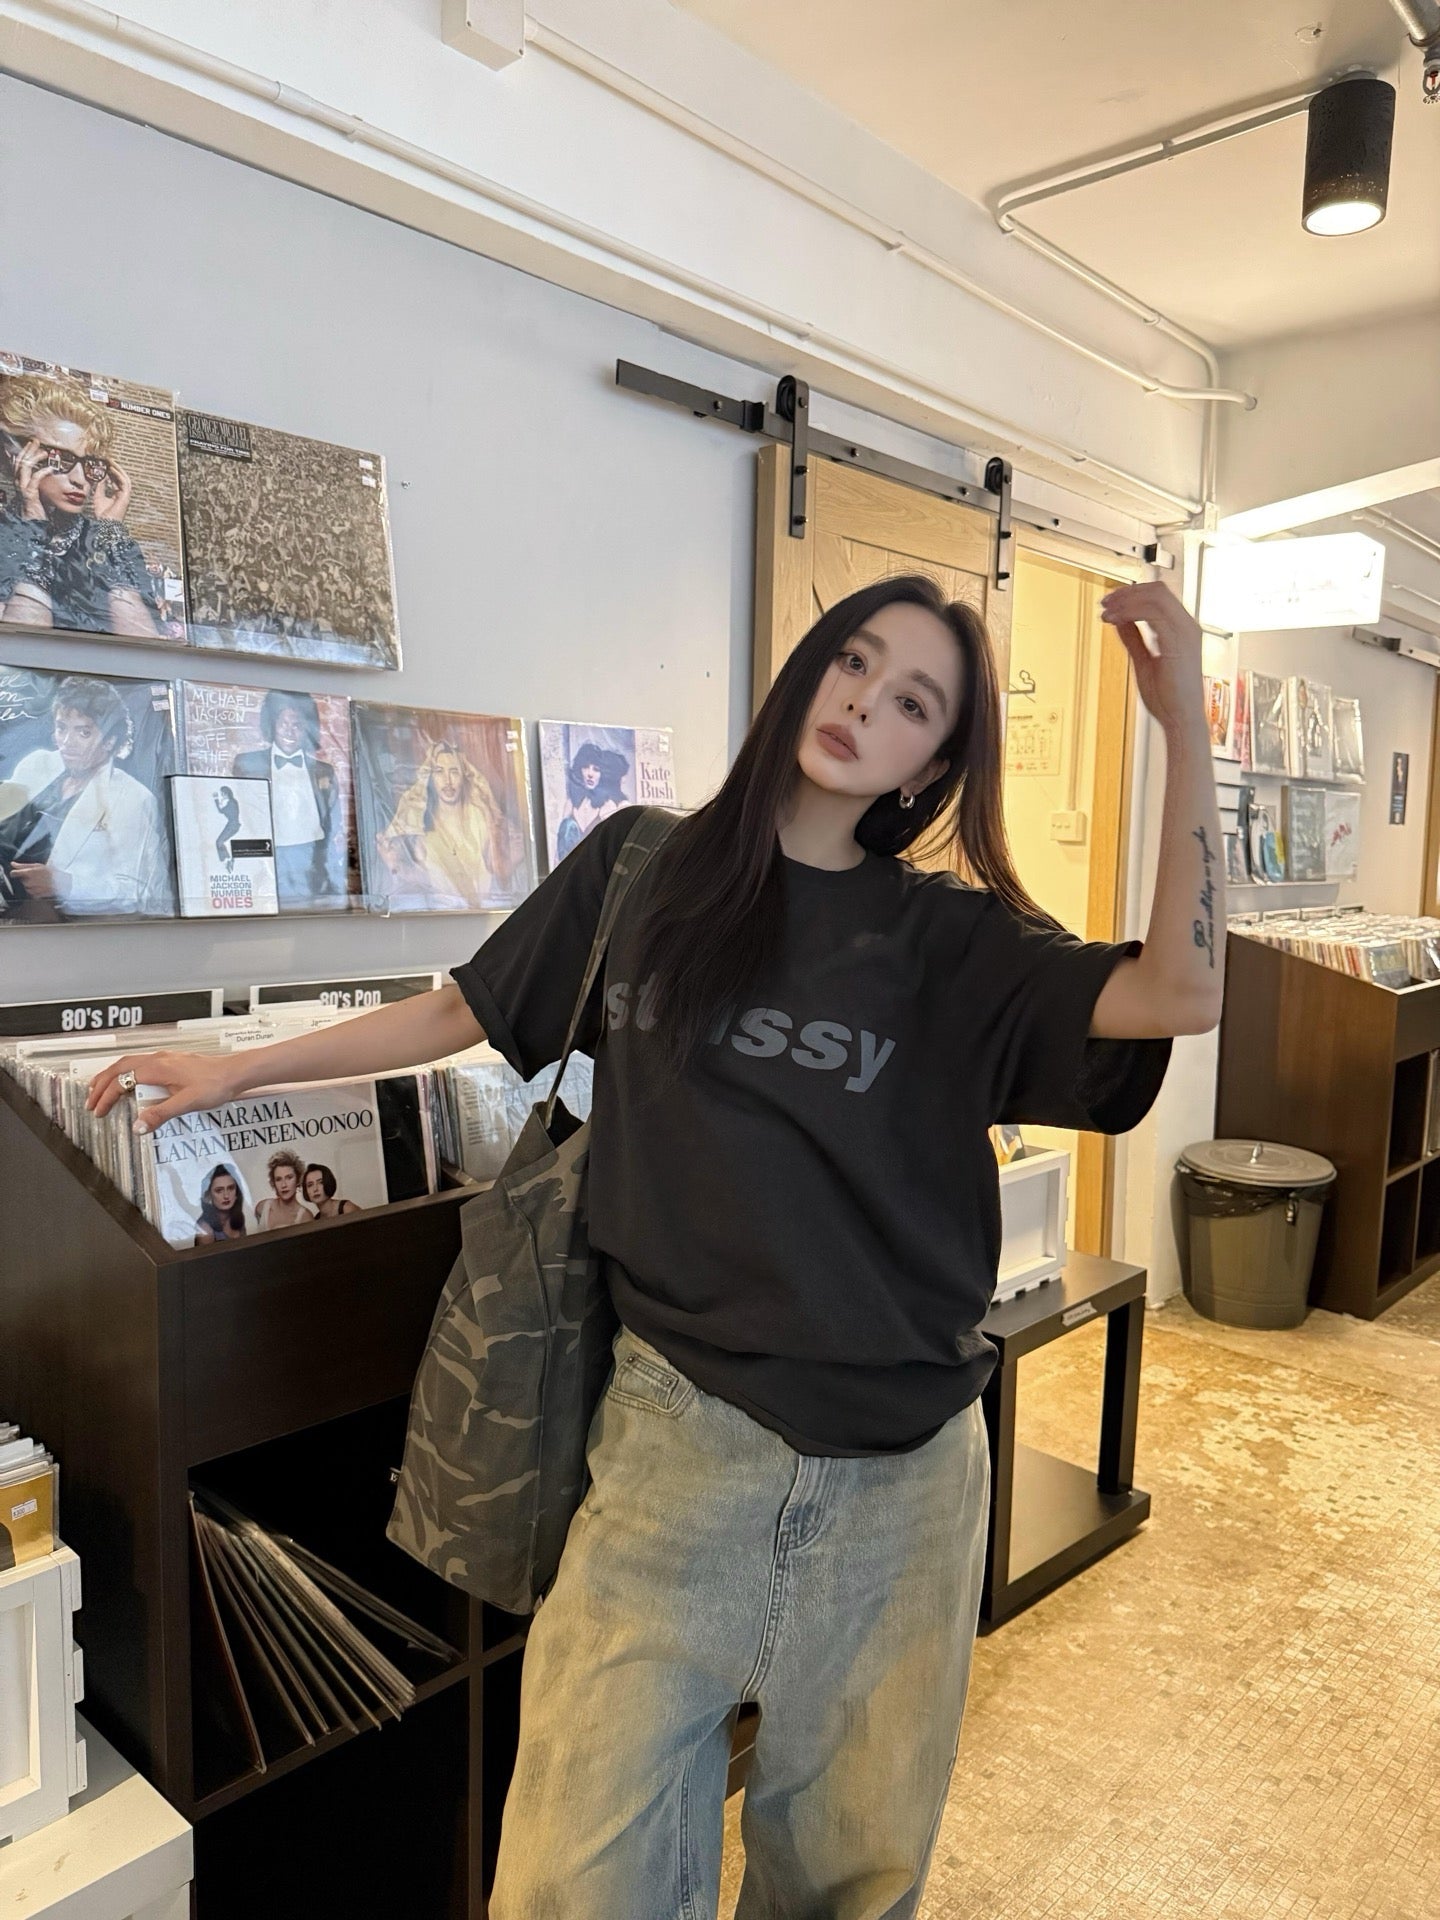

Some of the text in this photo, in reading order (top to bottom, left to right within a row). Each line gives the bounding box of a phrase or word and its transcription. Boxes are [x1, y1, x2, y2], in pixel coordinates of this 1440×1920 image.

[121, 401, 151, 415] NUMBER
[152, 409, 171, 420] ONES
[192, 687, 255, 708] MICHAEL
[192, 705, 246, 726] JACKSON
[195, 733, 226, 750] OFF
[199, 750, 229, 764] THE
[640, 762, 671, 781] Kate
[640, 780, 674, 800] Bush
[209, 874, 252, 883] MICHAEL
[210, 882, 252, 890] JACKSON
[211, 889, 253, 898] NUMBER
[212, 897, 254, 909] ONES
[319, 990, 352, 1008] 80's
[61, 1005, 143, 1031] 80's Pop
[236, 1034, 256, 1043] Duran
[255, 1032, 275, 1041] Duran
[606, 971, 897, 1093] stssy
[154, 1108, 374, 1165] LANANEENEENOONOO
